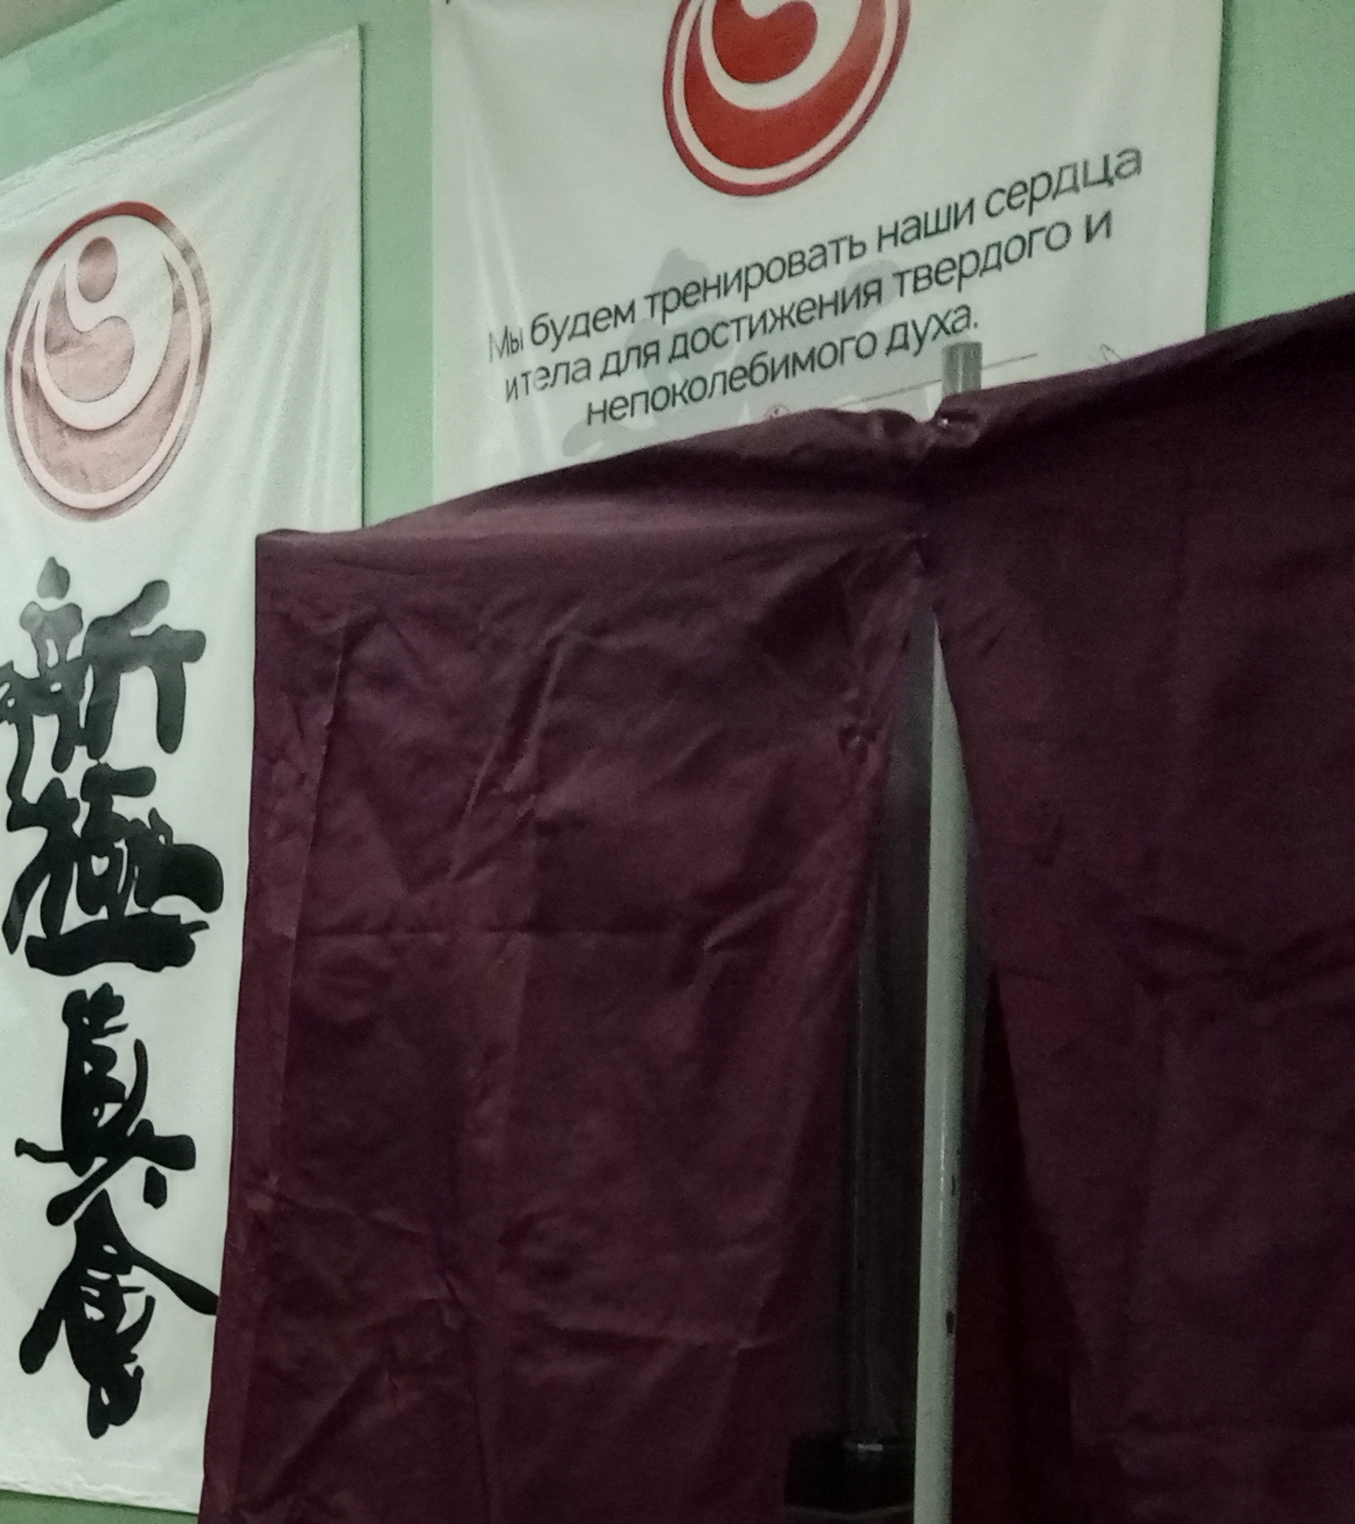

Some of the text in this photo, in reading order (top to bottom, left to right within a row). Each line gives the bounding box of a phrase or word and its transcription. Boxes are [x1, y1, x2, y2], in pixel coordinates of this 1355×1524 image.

[488, 148, 1142, 363] Мы будем тренировать наши сердца
[599, 340, 660, 381] для
[668, 276, 883, 364] достижения
[892, 221, 1072, 292] твердого
[1085, 209, 1112, 244] и
[587, 303, 978, 426] непоколебимого духа.
